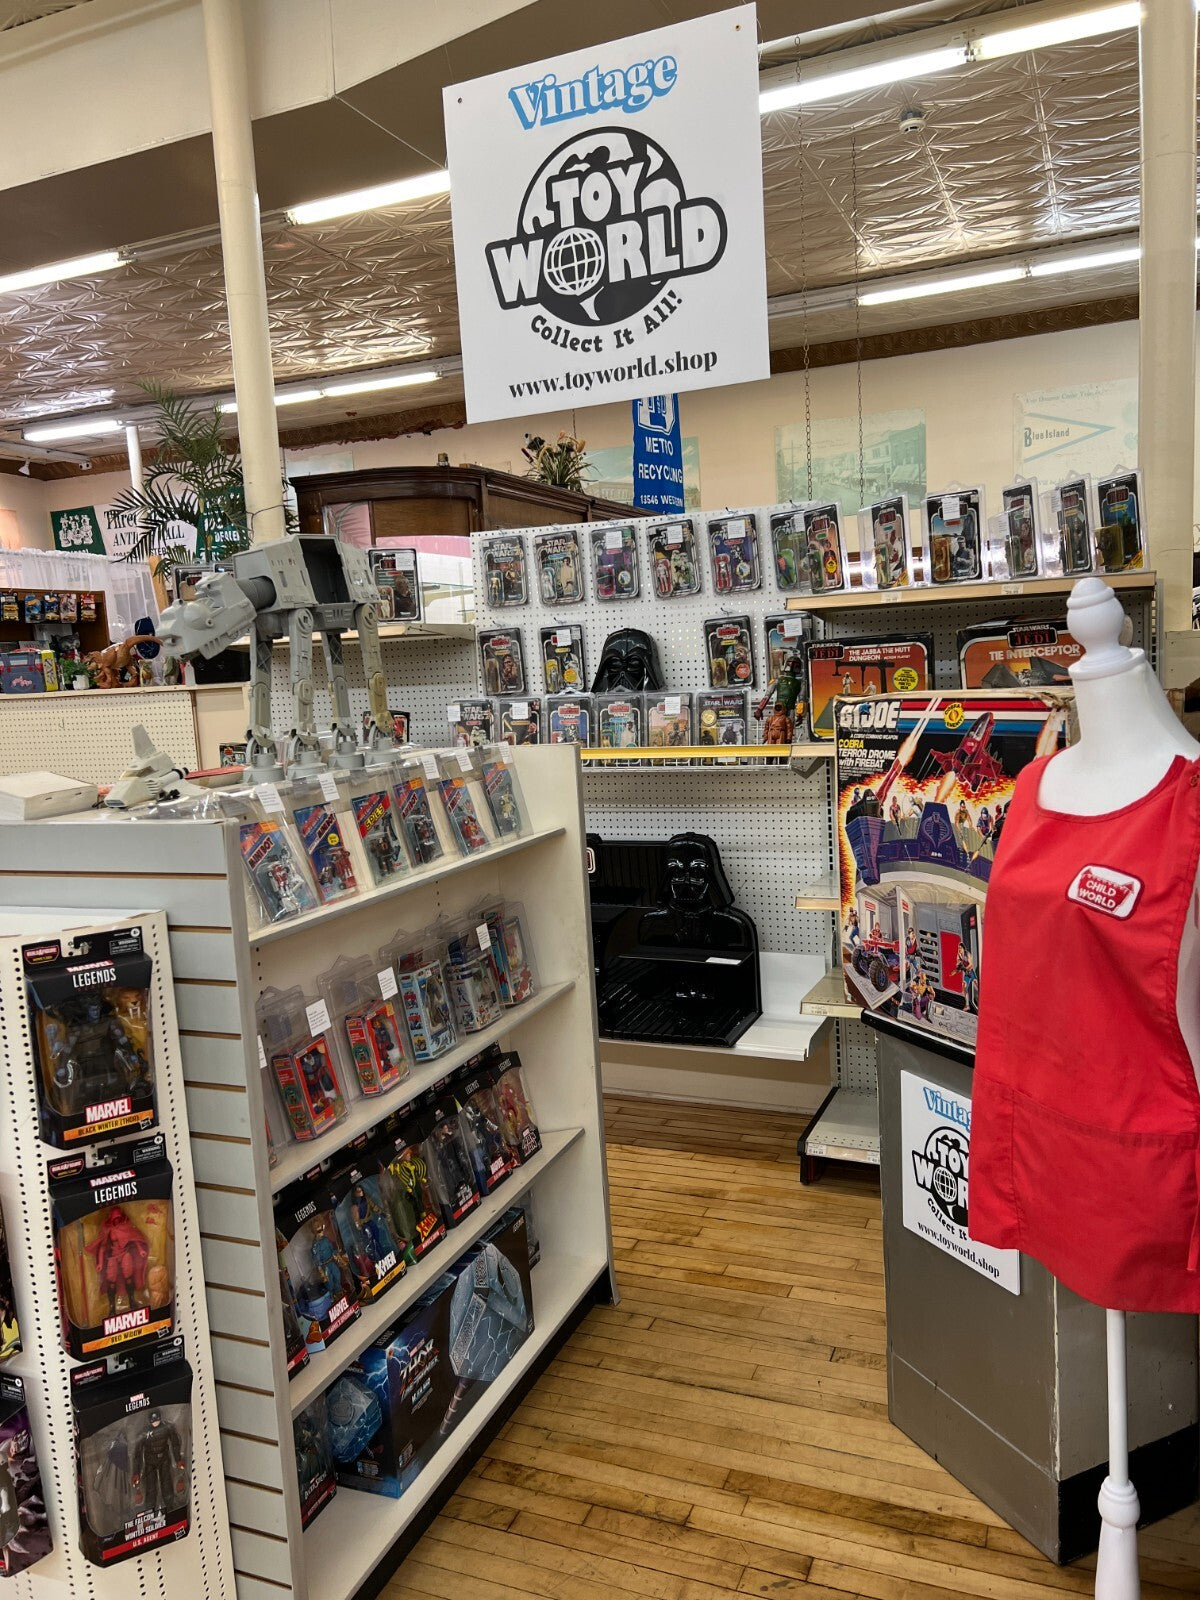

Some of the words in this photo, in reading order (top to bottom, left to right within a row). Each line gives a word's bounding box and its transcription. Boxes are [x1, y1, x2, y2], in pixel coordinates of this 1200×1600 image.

[508, 55, 678, 130] Vintage
[551, 161, 644, 228] TOY
[490, 204, 722, 303] WORLD
[531, 314, 603, 353] Collect
[614, 327, 634, 348] It
[644, 290, 684, 334] All!
[509, 348, 718, 398] www.toyworld.shop
[640, 495, 658, 504] 13546
[1014, 632, 1050, 645] JEDI
[813, 649, 839, 658] JEDI
[989, 651, 1004, 660] TIE
[1006, 644, 1081, 659] INTERCEPTOR
[464, 706, 482, 714] STAR
[839, 739, 864, 748] COBRA
[839, 749, 867, 758] TERROR
[868, 750, 896, 759] DROME
[839, 758, 854, 766] with
[855, 759, 885, 768] FIREBAT
[365, 805, 384, 829] SPIES
[1080, 888, 1116, 908] WORLD
[1086, 880, 1116, 896] CHILD
[66, 961, 112, 973] MARVEL
[73, 968, 116, 988] LEGENDS
[86, 1098, 131, 1123] MARVEL
[78, 1126, 97, 1136] BLACK
[98, 1121, 119, 1131] WINTER
[90, 1170, 136, 1187] MARVEL
[95, 1182, 137, 1204] LEGENDS
[294, 1201, 317, 1223] LEGENDS
[927, 1198, 955, 1235] Collect
[959, 1229, 967, 1240] It
[918, 1222, 1000, 1278] www.toyworld.shop
[329, 1297, 349, 1322] MARVEL
[104, 1308, 149, 1335] MARVEL
[126, 1397, 150, 1412] LEGENDS
[125, 1521, 134, 1529] THE
[135, 1513, 154, 1525] FALCON
[125, 1529, 144, 1541] WINTER
[146, 1521, 166, 1534] SOLDIER
[133, 1539, 142, 1548] U.S.
[144, 1532, 159, 1543] AGENT
